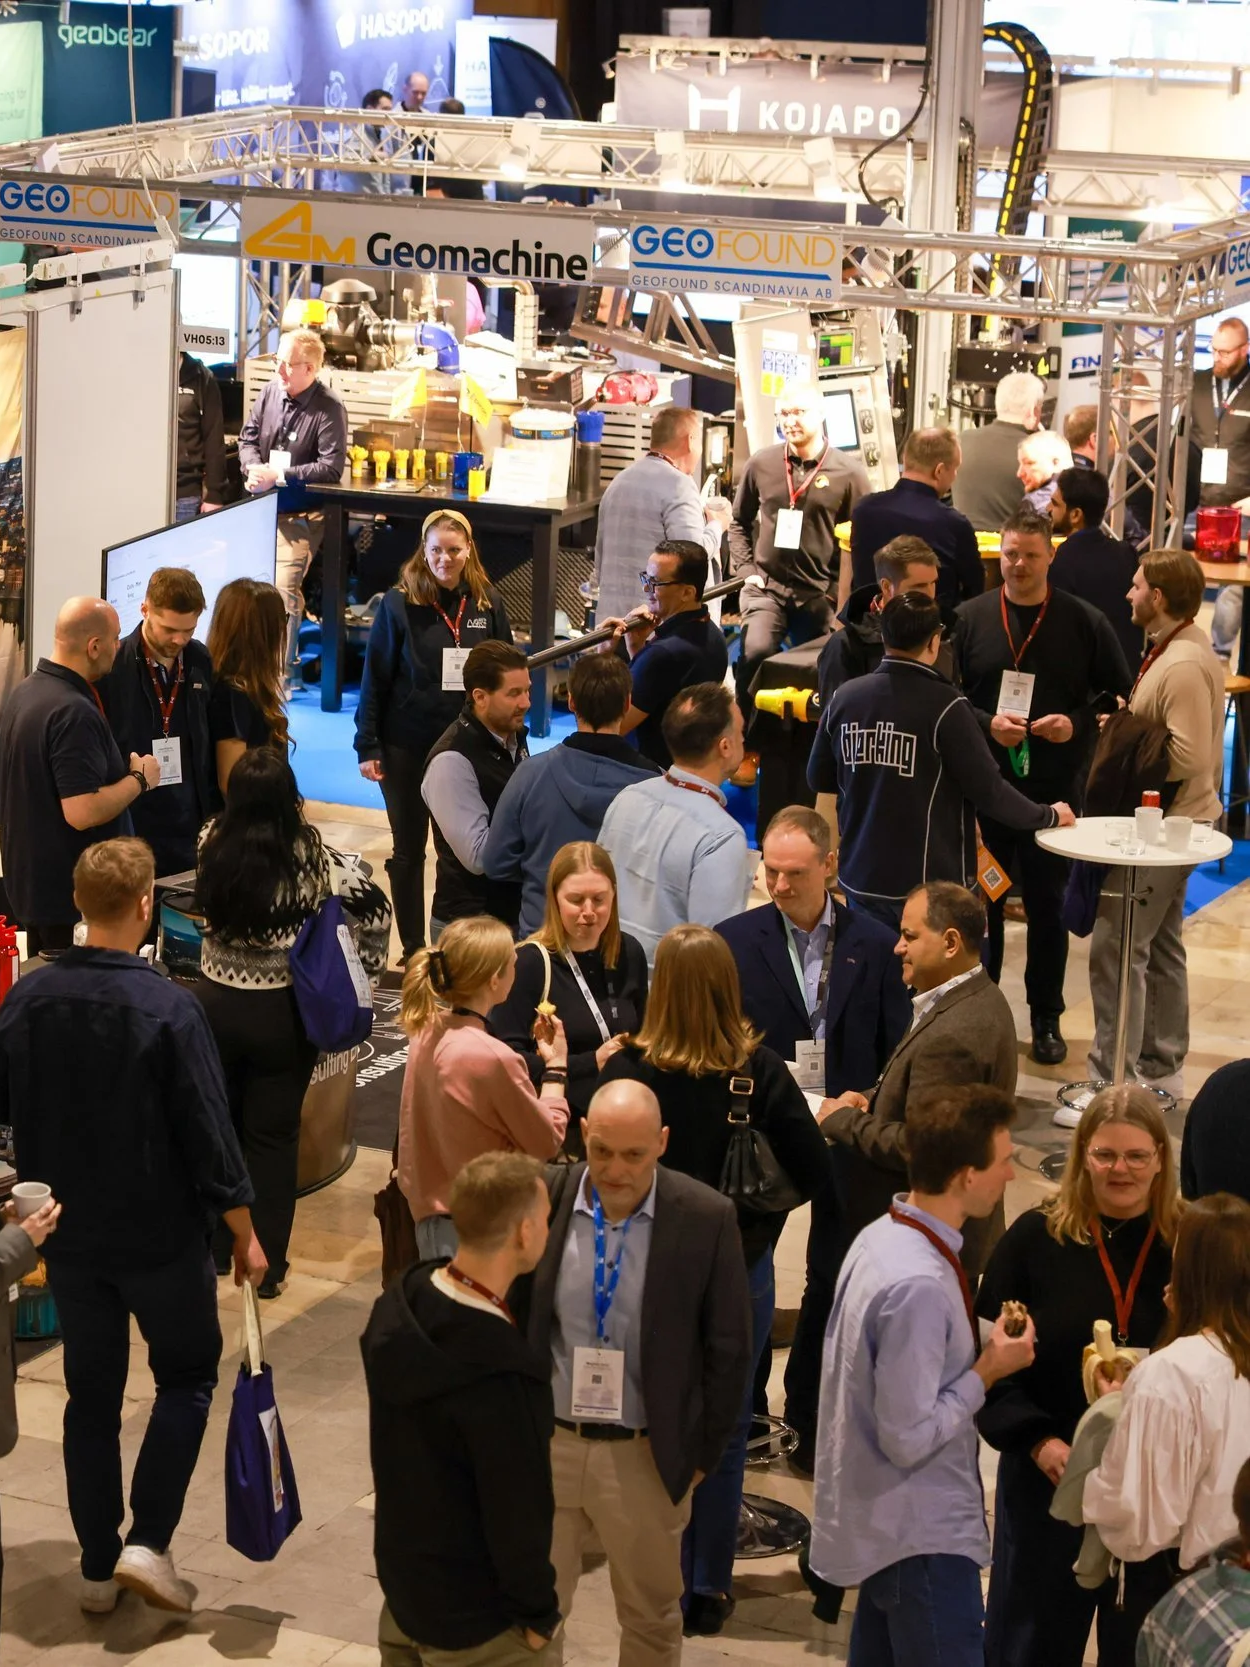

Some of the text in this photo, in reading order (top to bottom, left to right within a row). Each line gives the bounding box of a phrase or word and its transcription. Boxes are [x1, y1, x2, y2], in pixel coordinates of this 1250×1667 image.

[57, 23, 158, 49] geobear
[360, 5, 445, 40] HASOPOR
[182, 27, 270, 62] SOPOR
[758, 100, 901, 138] KOJAPO
[0, 181, 175, 220] GEOFOUND
[0, 228, 66, 242] GEOFOUND
[632, 225, 836, 267] GEOFOUND
[366, 232, 588, 281] Geomachine
[631, 274, 832, 299] GEOFOUND SCANDINAVIA AB
[183, 333, 225, 346] VH05:13
[310, 1051, 349, 1086] sulting
